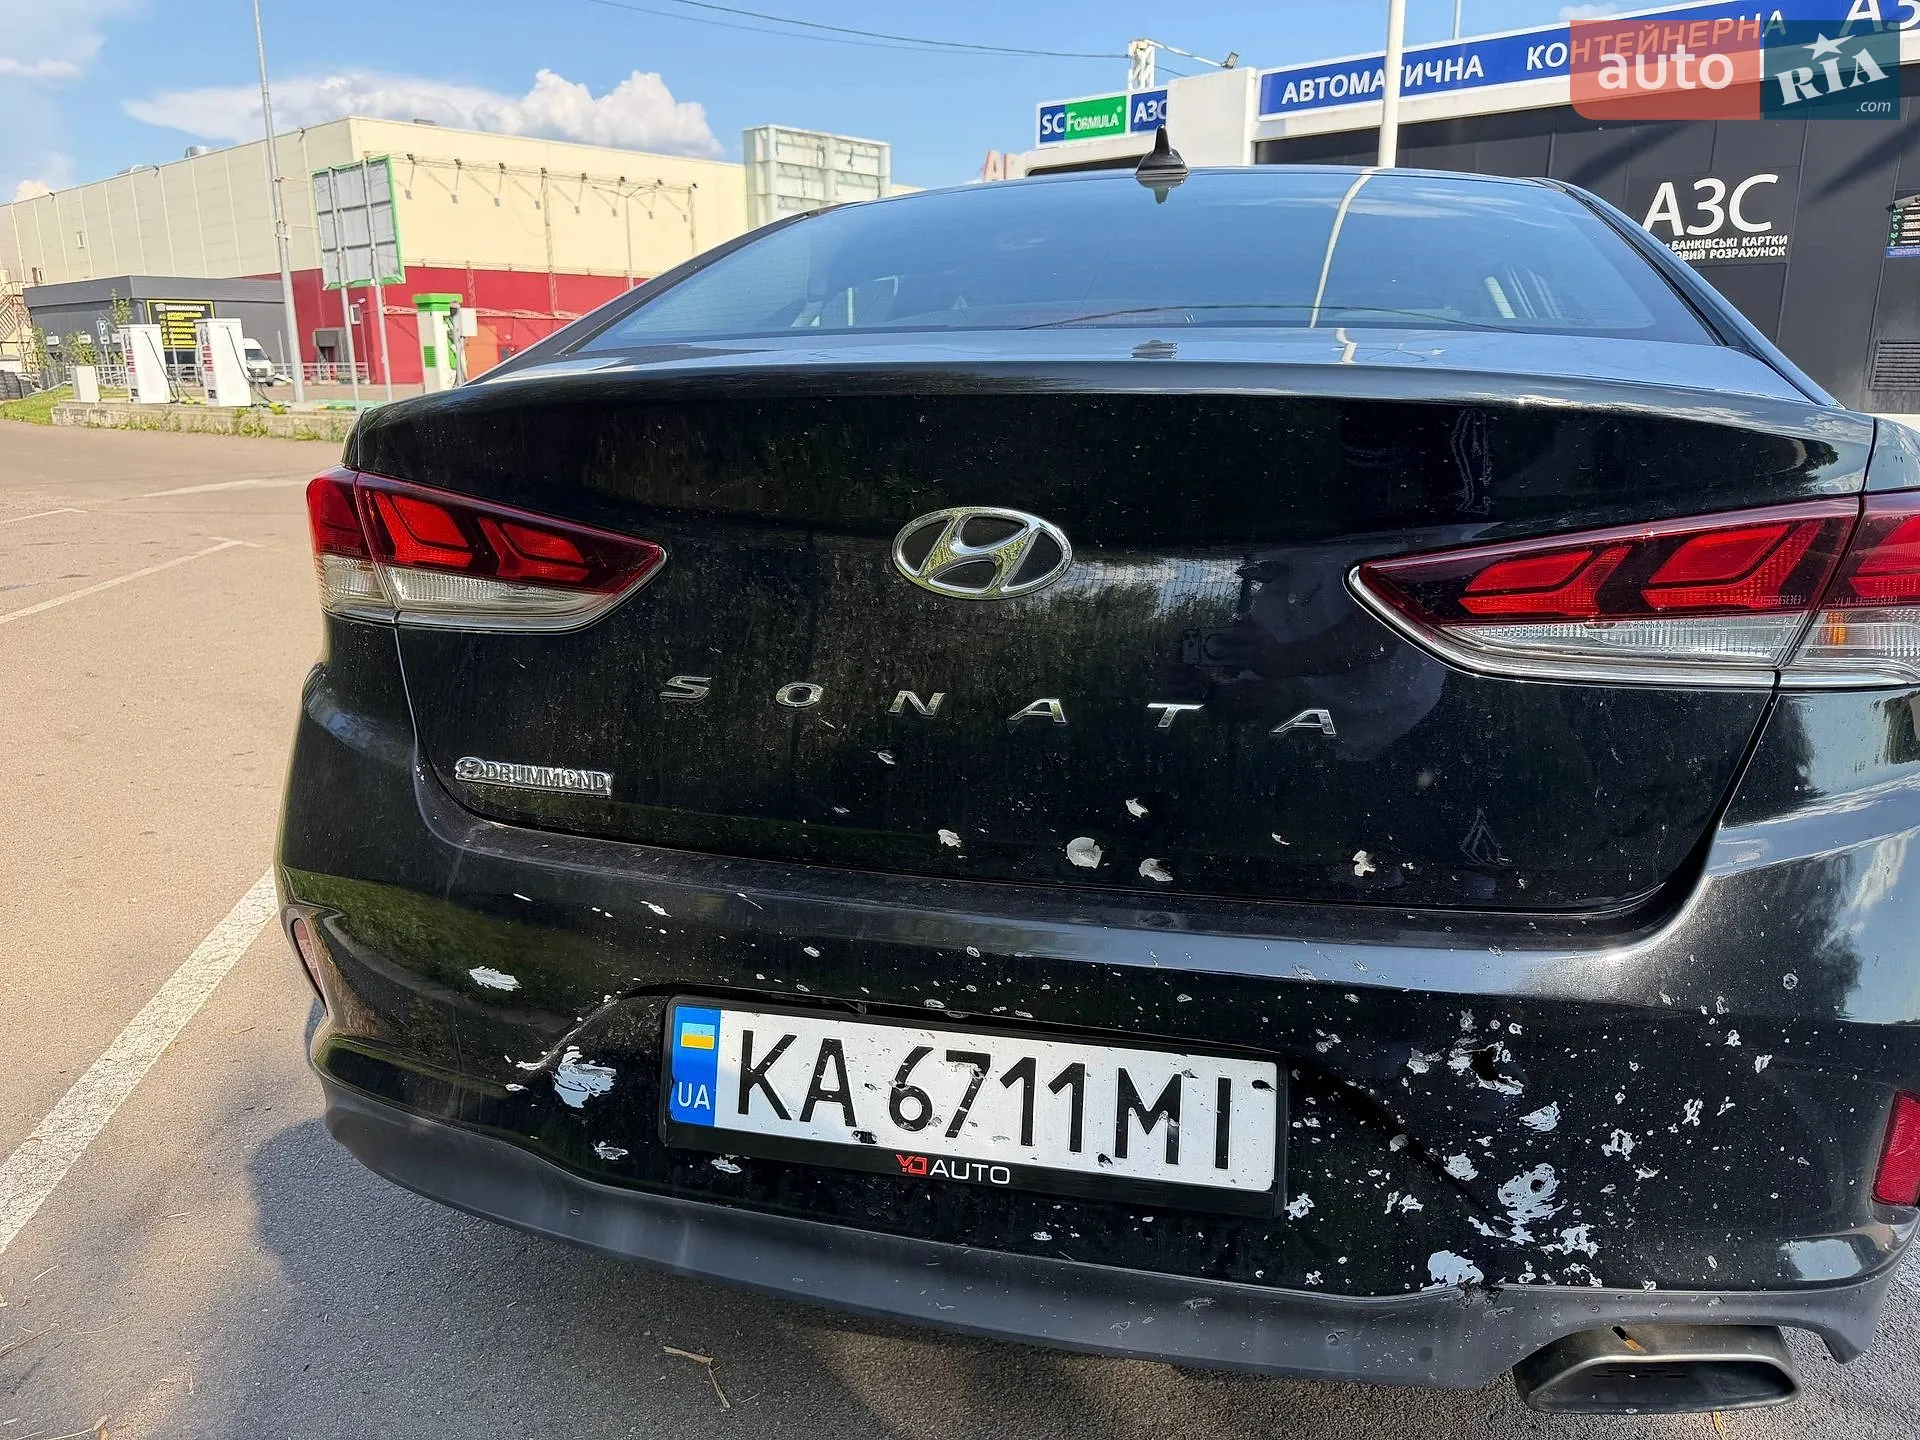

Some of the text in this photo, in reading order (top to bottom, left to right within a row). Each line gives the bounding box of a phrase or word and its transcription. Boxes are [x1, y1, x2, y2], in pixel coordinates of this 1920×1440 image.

[1281, 54, 1484, 104] АВТОМАИЧНА
[1526, 9, 1787, 70] КОНТЕЙНЕРНА
[1041, 112, 1065, 135] SC
[1642, 174, 1779, 236] АЗС
[1671, 234, 1788, 251] БАНКІВСЬКІ КАРТКИ
[1709, 245, 1786, 259] РОЗРАХУНОК
[660, 674, 1336, 736] SONATA
[486, 760, 612, 793] DRUMMOND
[677, 1083, 711, 1111] UA
